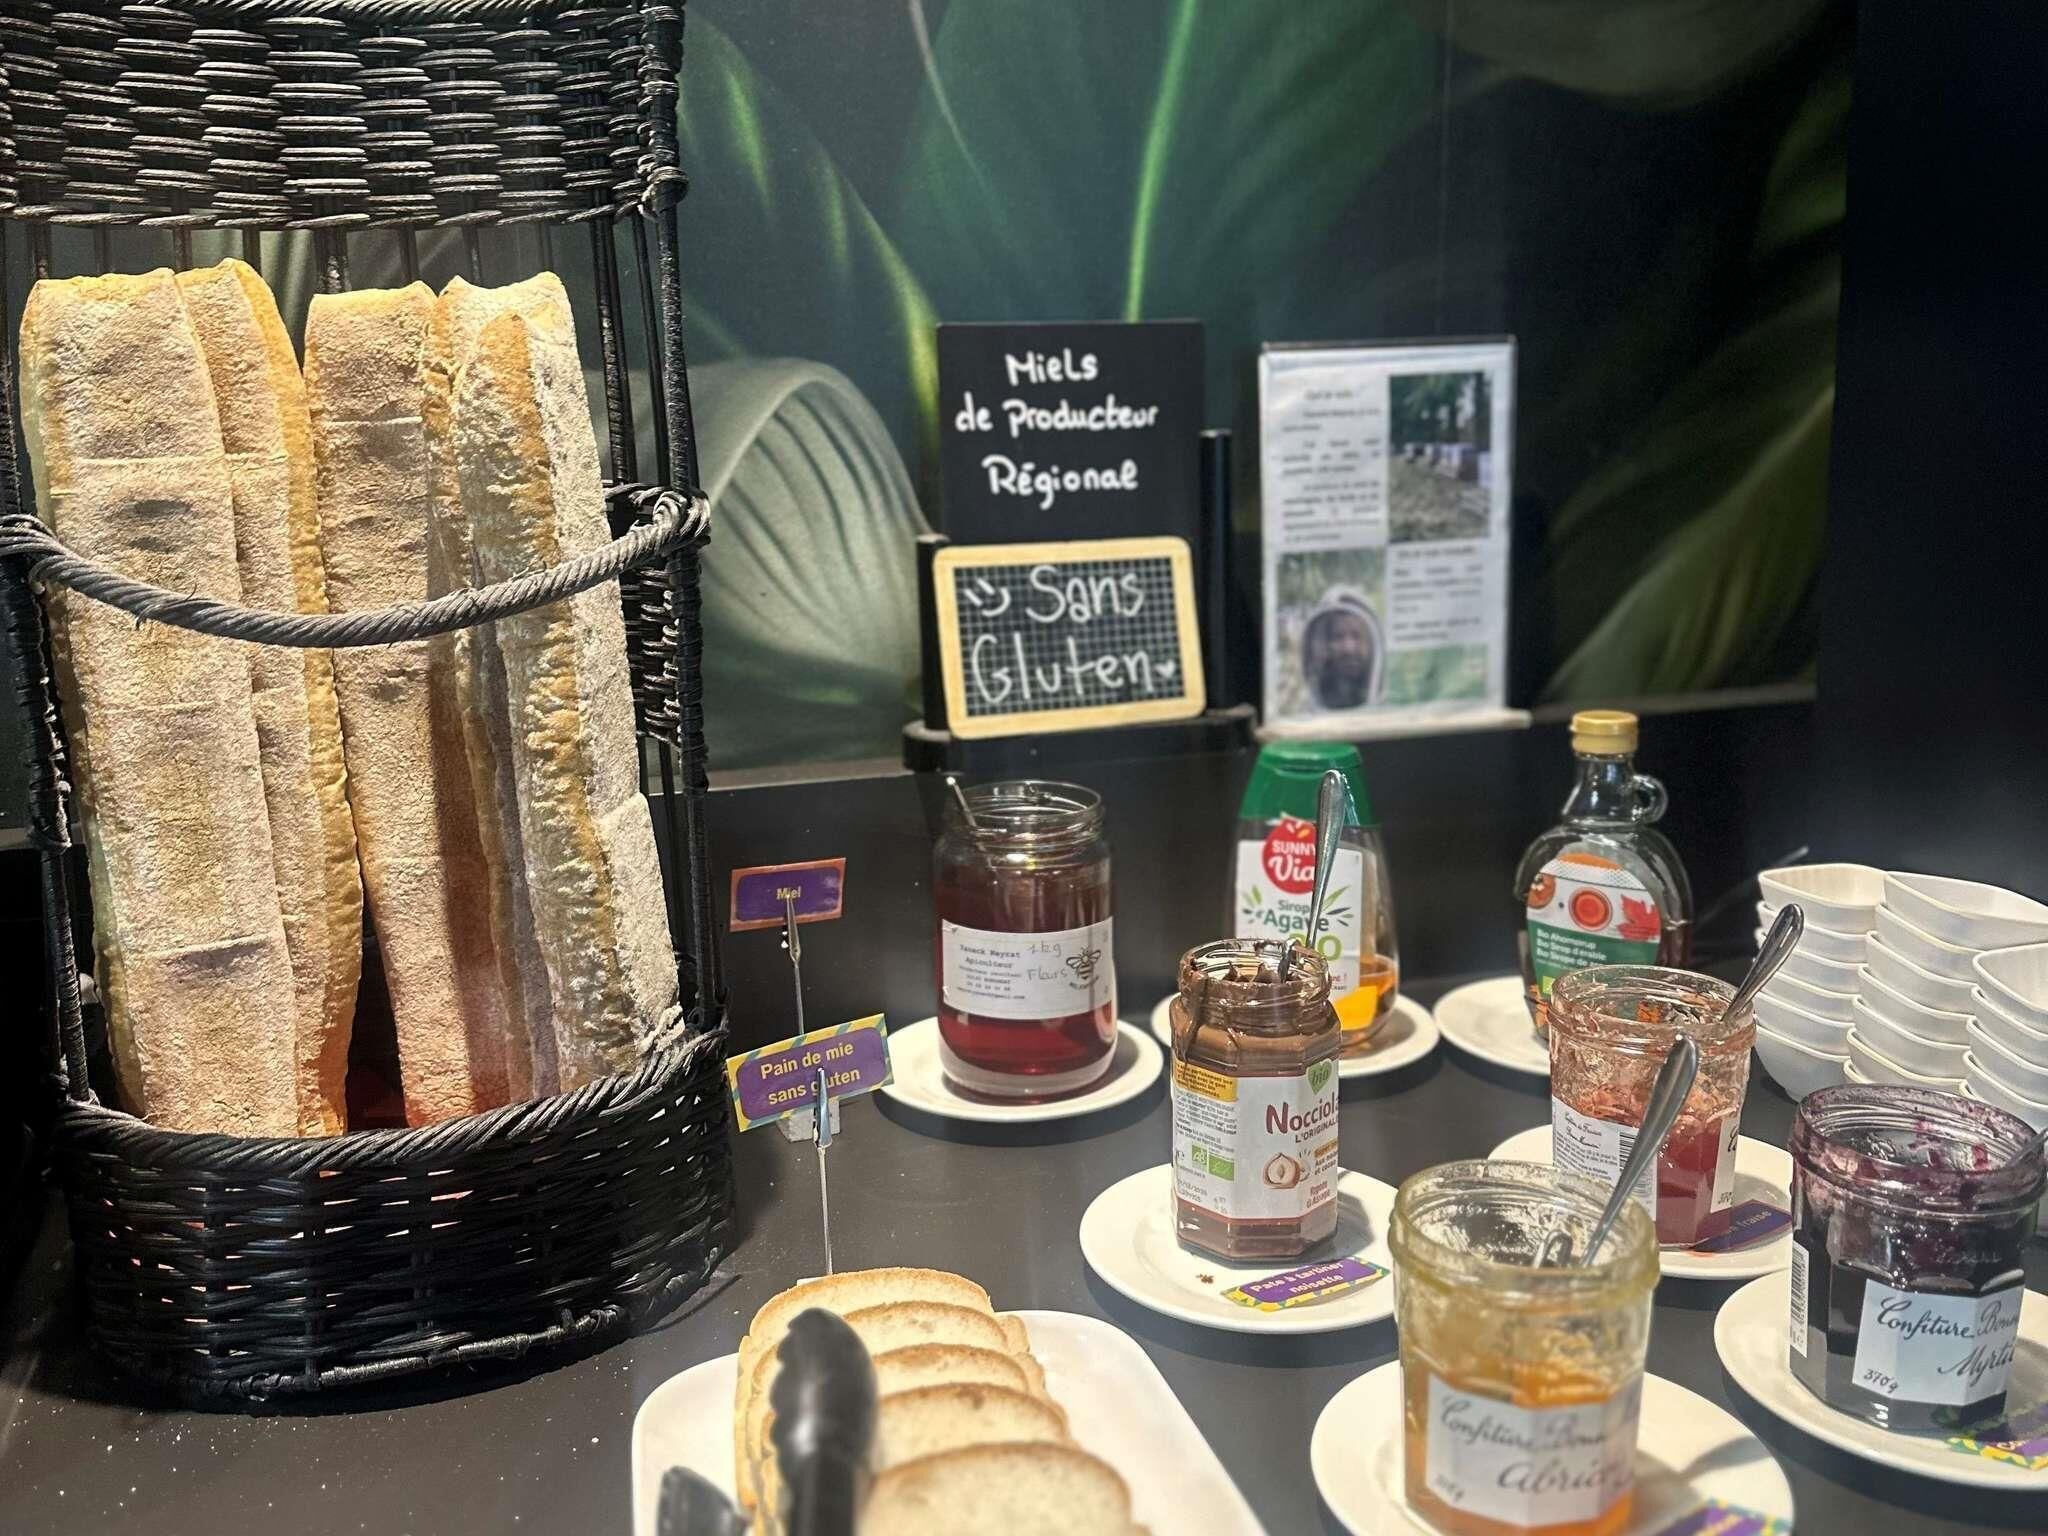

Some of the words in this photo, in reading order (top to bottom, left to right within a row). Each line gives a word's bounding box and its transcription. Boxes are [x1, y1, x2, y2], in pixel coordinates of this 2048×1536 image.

[1005, 348, 1099, 386] Miels
[955, 391, 993, 431] de
[1002, 394, 1159, 437] Producteur
[981, 454, 1139, 509] Régional
[1025, 564, 1144, 623] Sans
[971, 632, 1155, 703] Gluten
[776, 886, 802, 900] Miel
[1278, 899, 1311, 915] Sirop
[761, 1059, 798, 1079] Pain
[802, 1052, 821, 1067] de
[826, 1042, 854, 1060] mie
[768, 1084, 807, 1105] sans
[810, 1069, 860, 1096] guten
[1288, 1275, 1344, 1293] noisette
[1877, 1297, 1975, 1340] Confiture
[1441, 1397, 1535, 1447] Confiture
